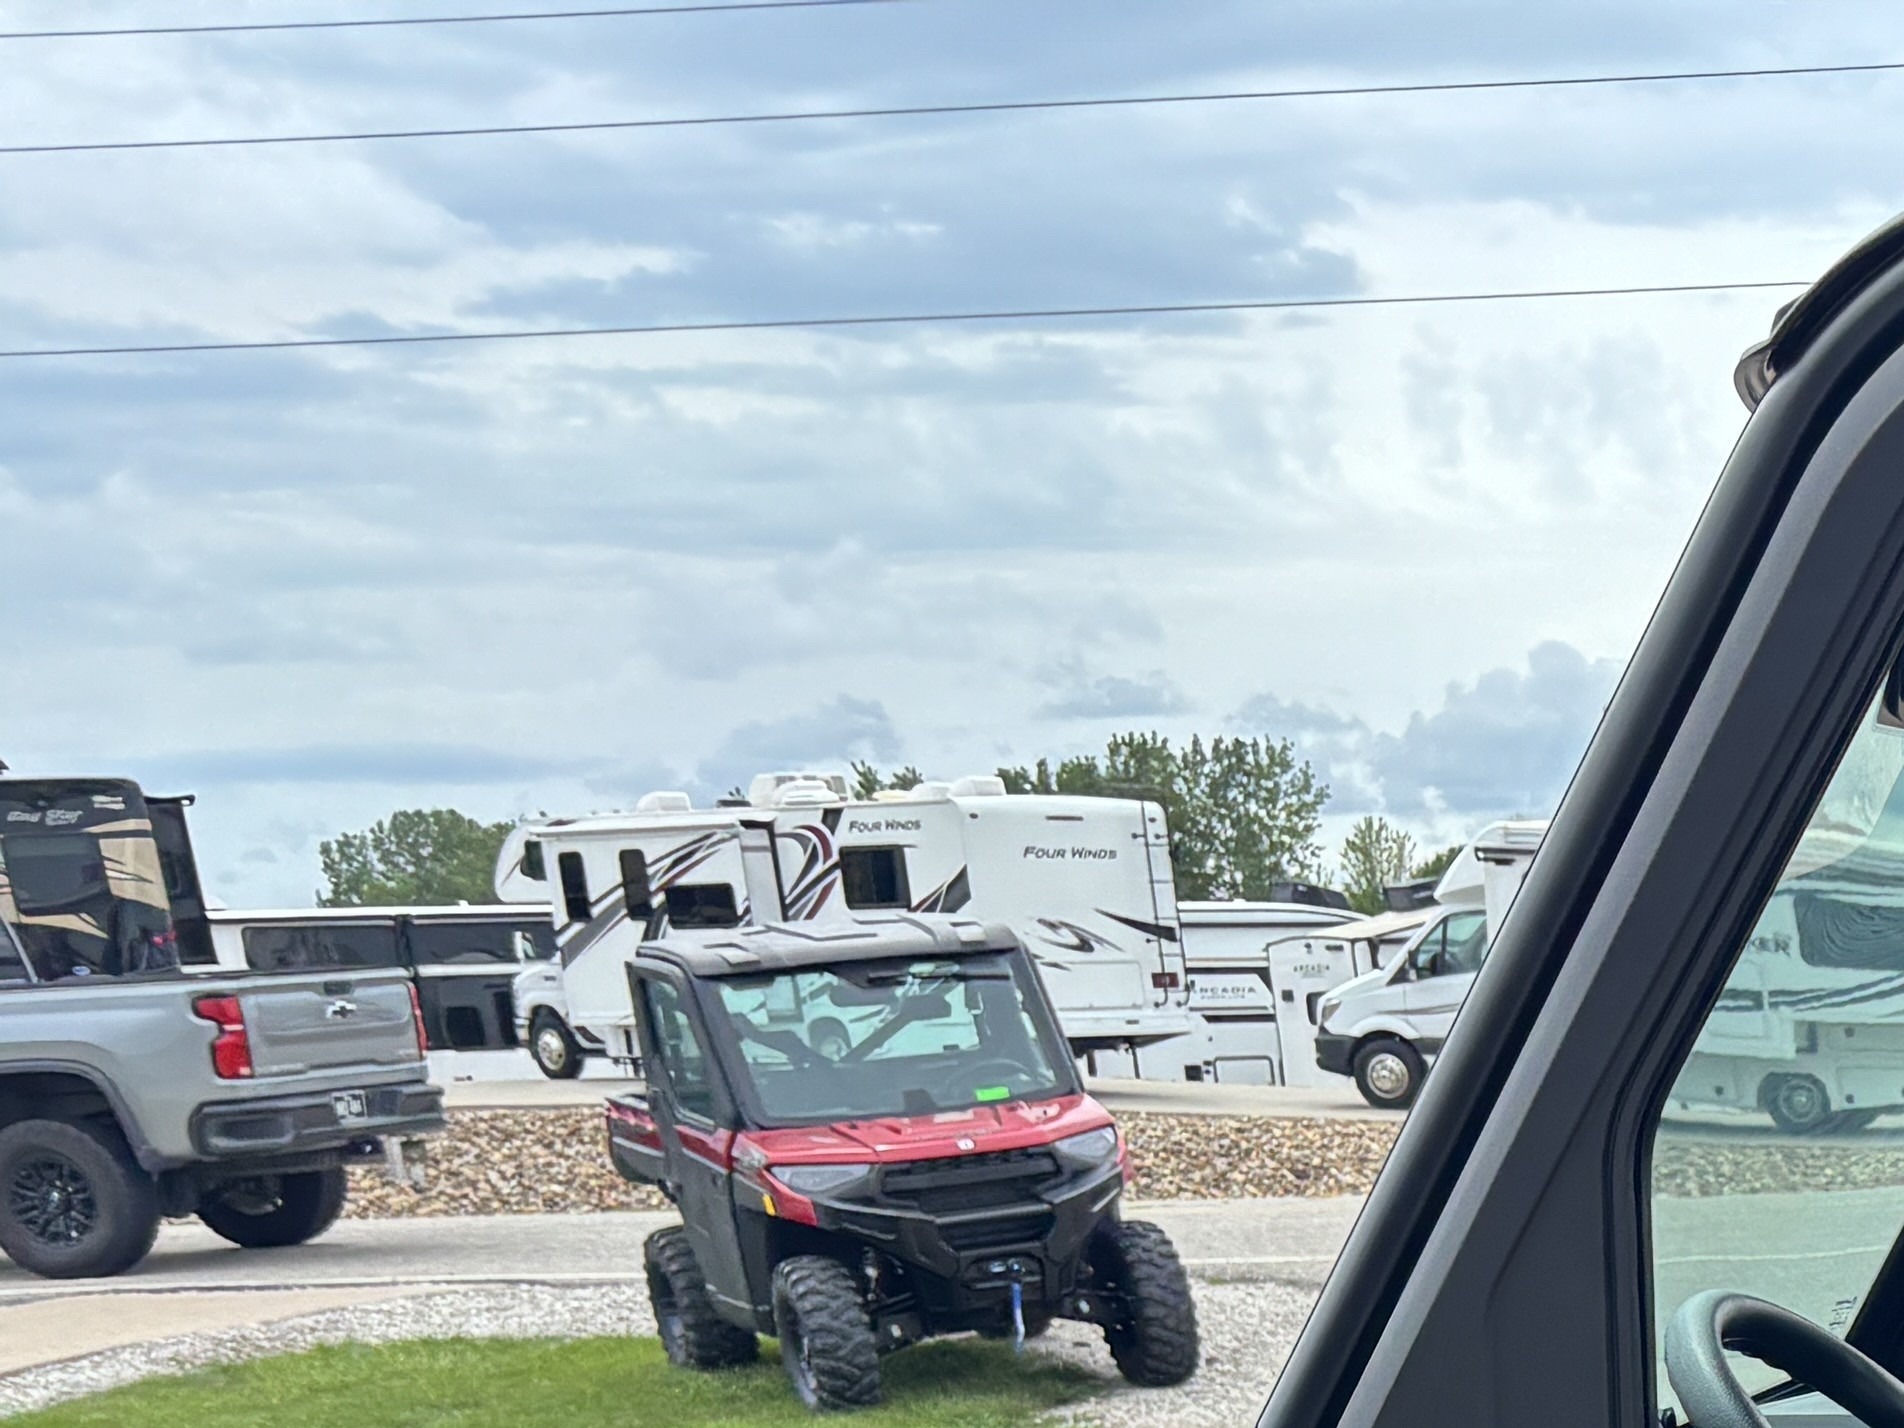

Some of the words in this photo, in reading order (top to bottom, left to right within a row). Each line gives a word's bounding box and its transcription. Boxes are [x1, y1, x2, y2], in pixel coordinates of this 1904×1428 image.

[849, 820, 881, 833] FOUR
[1023, 846, 1066, 859] FOUR
[1071, 847, 1117, 859] WINDS
